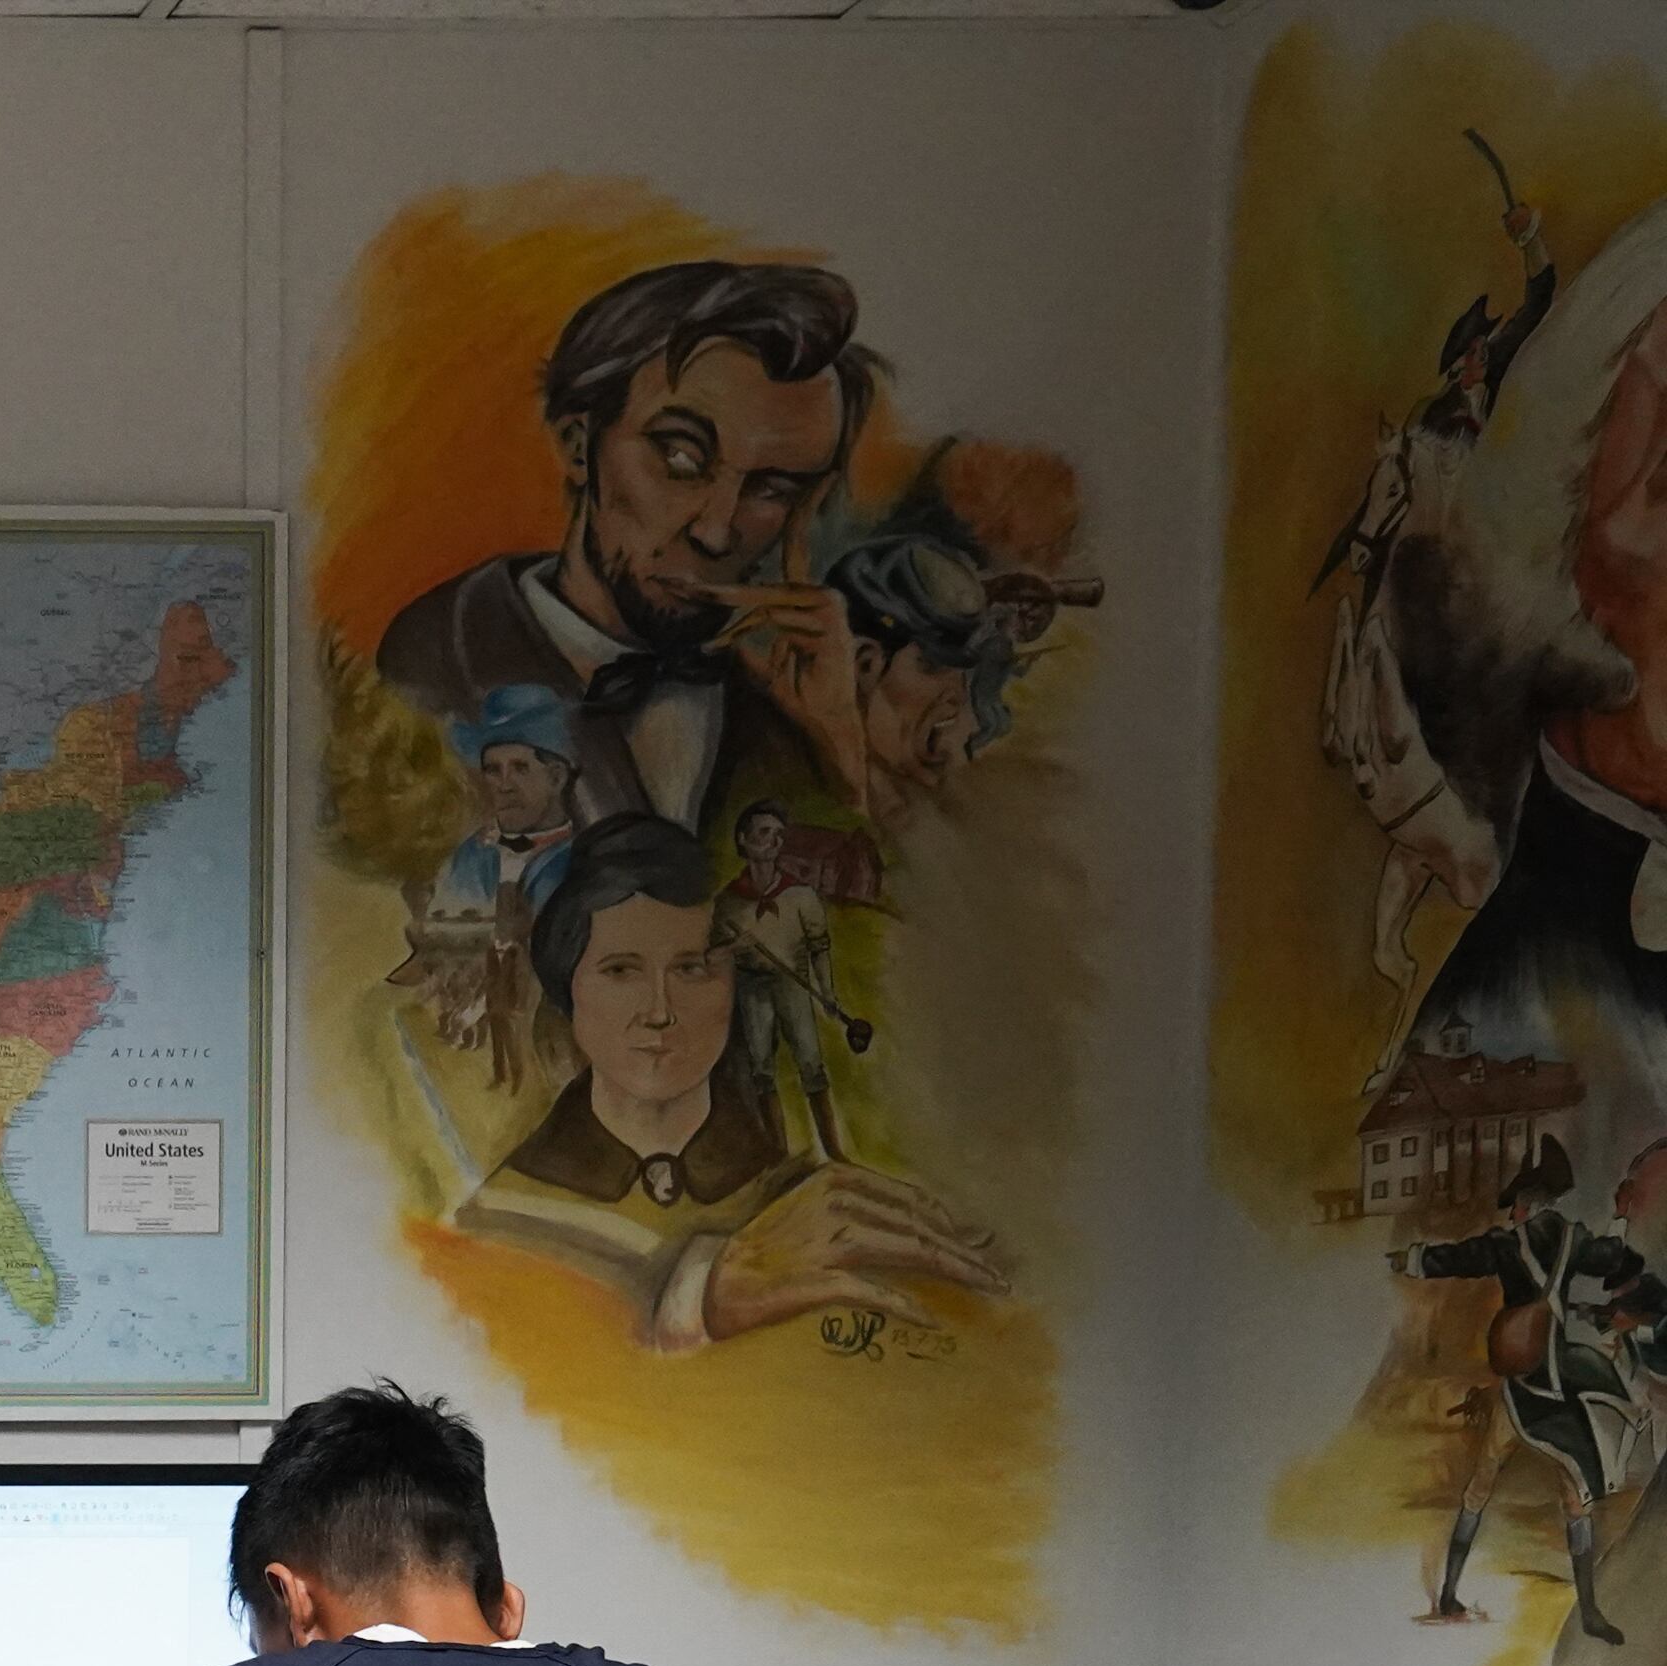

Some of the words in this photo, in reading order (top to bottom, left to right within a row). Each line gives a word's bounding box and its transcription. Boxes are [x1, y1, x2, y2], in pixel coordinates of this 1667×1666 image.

[110, 1047, 211, 1058] ATLANTIC
[128, 1078, 195, 1088] OCEAN
[128, 1128, 152, 1137] RAND
[105, 1142, 154, 1158] United
[158, 1142, 204, 1158] States
[5, 1261, 38, 1269] FLORIDA
